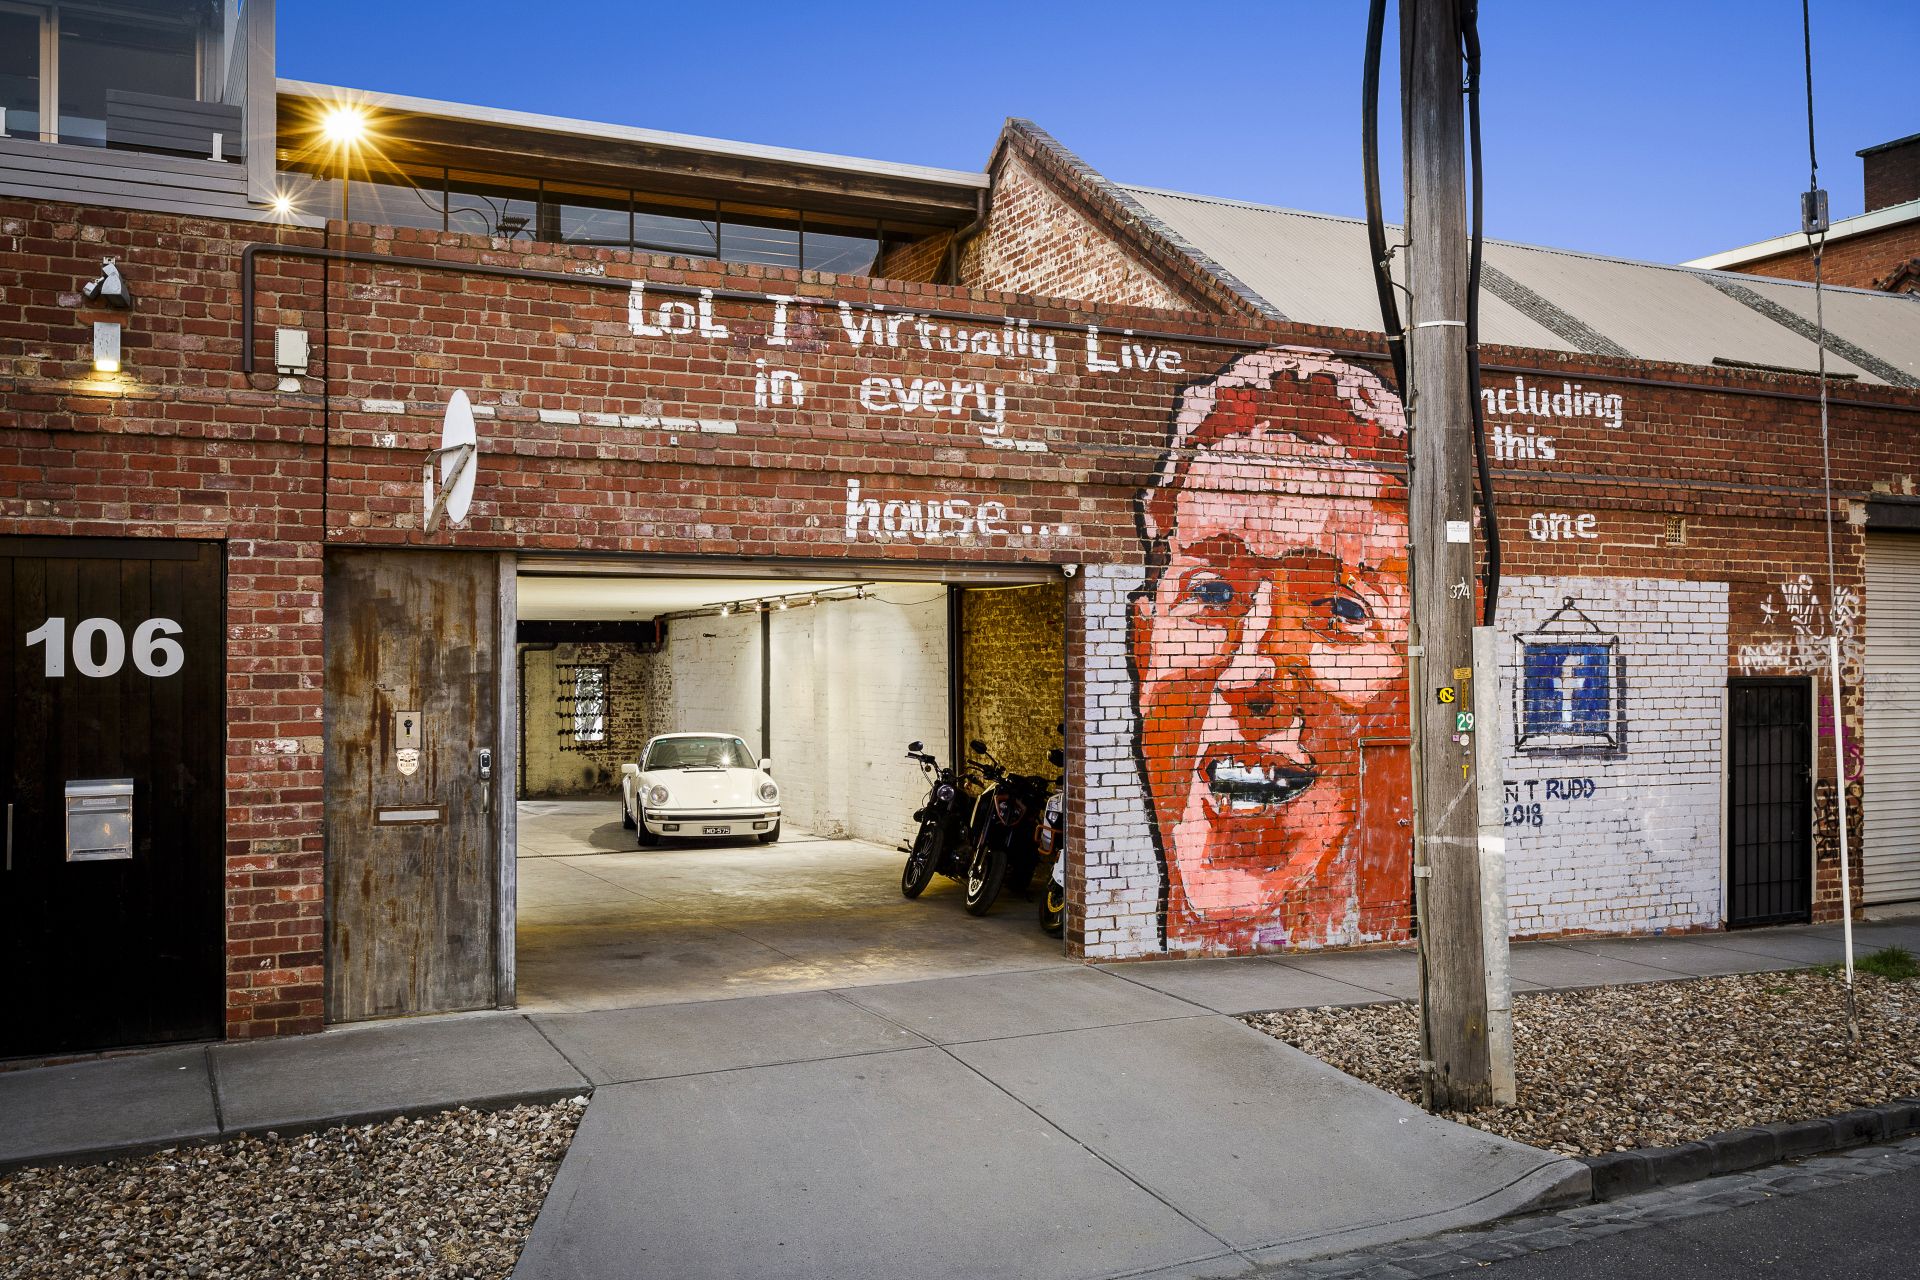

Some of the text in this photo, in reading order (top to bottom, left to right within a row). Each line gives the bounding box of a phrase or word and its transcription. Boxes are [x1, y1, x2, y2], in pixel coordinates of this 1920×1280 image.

[1085, 325, 1186, 375] Live
[755, 358, 1006, 435] in every
[1481, 376, 1623, 428] ncluding
[1491, 425, 1556, 461] this
[1529, 512, 1599, 541] one
[26, 617, 185, 678] 106
[1457, 712, 1475, 731] 29
[1503, 779, 1596, 803] NT RUDD
[1504, 803, 1543, 827] 2018
